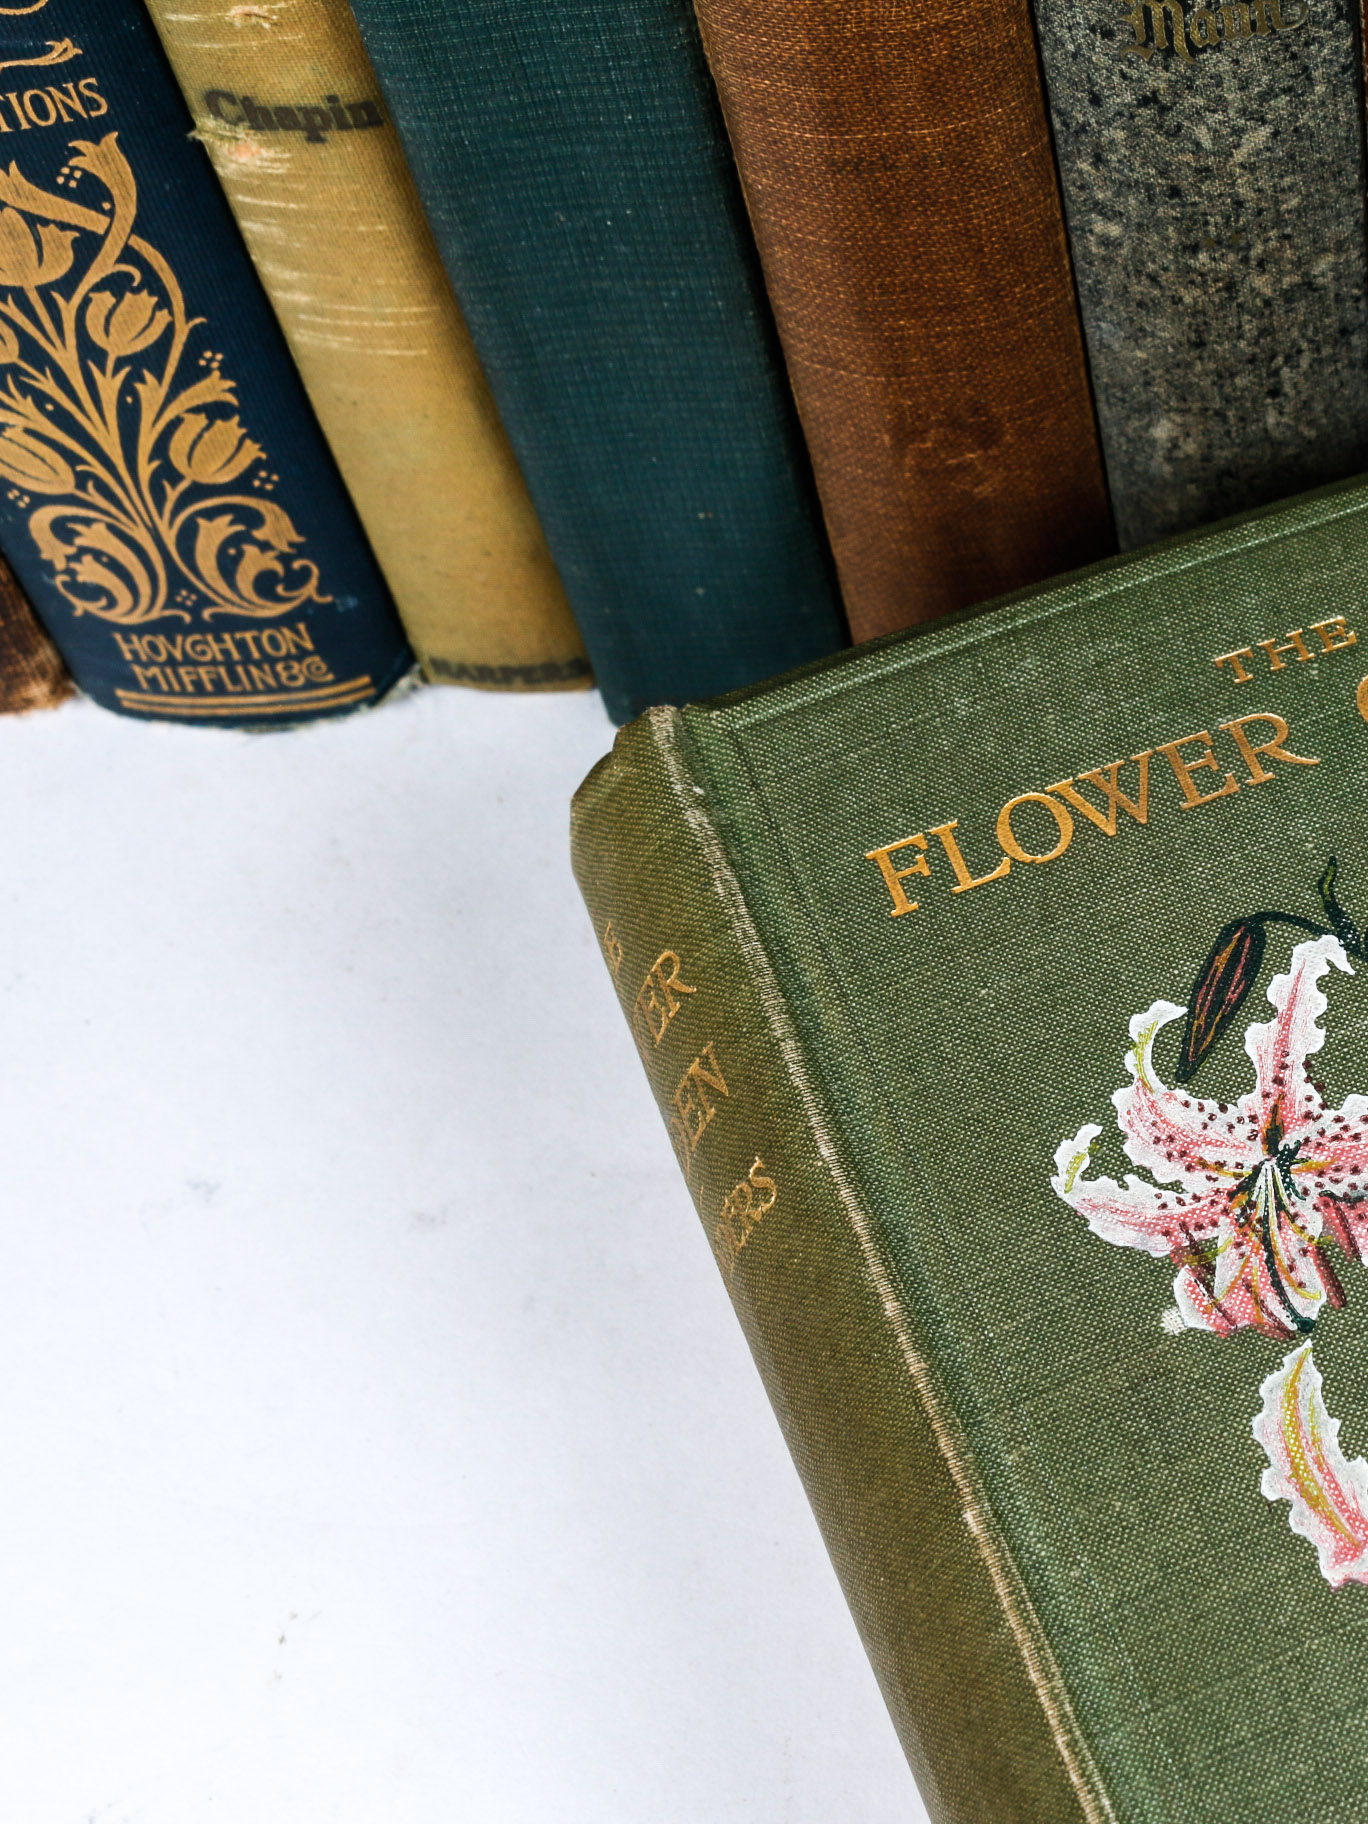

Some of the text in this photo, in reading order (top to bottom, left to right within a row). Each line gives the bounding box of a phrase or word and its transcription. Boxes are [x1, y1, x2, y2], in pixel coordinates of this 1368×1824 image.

[205, 90, 385, 144] Chapin
[1214, 616, 1356, 685] THE
[866, 712, 1320, 917] FLOWER
